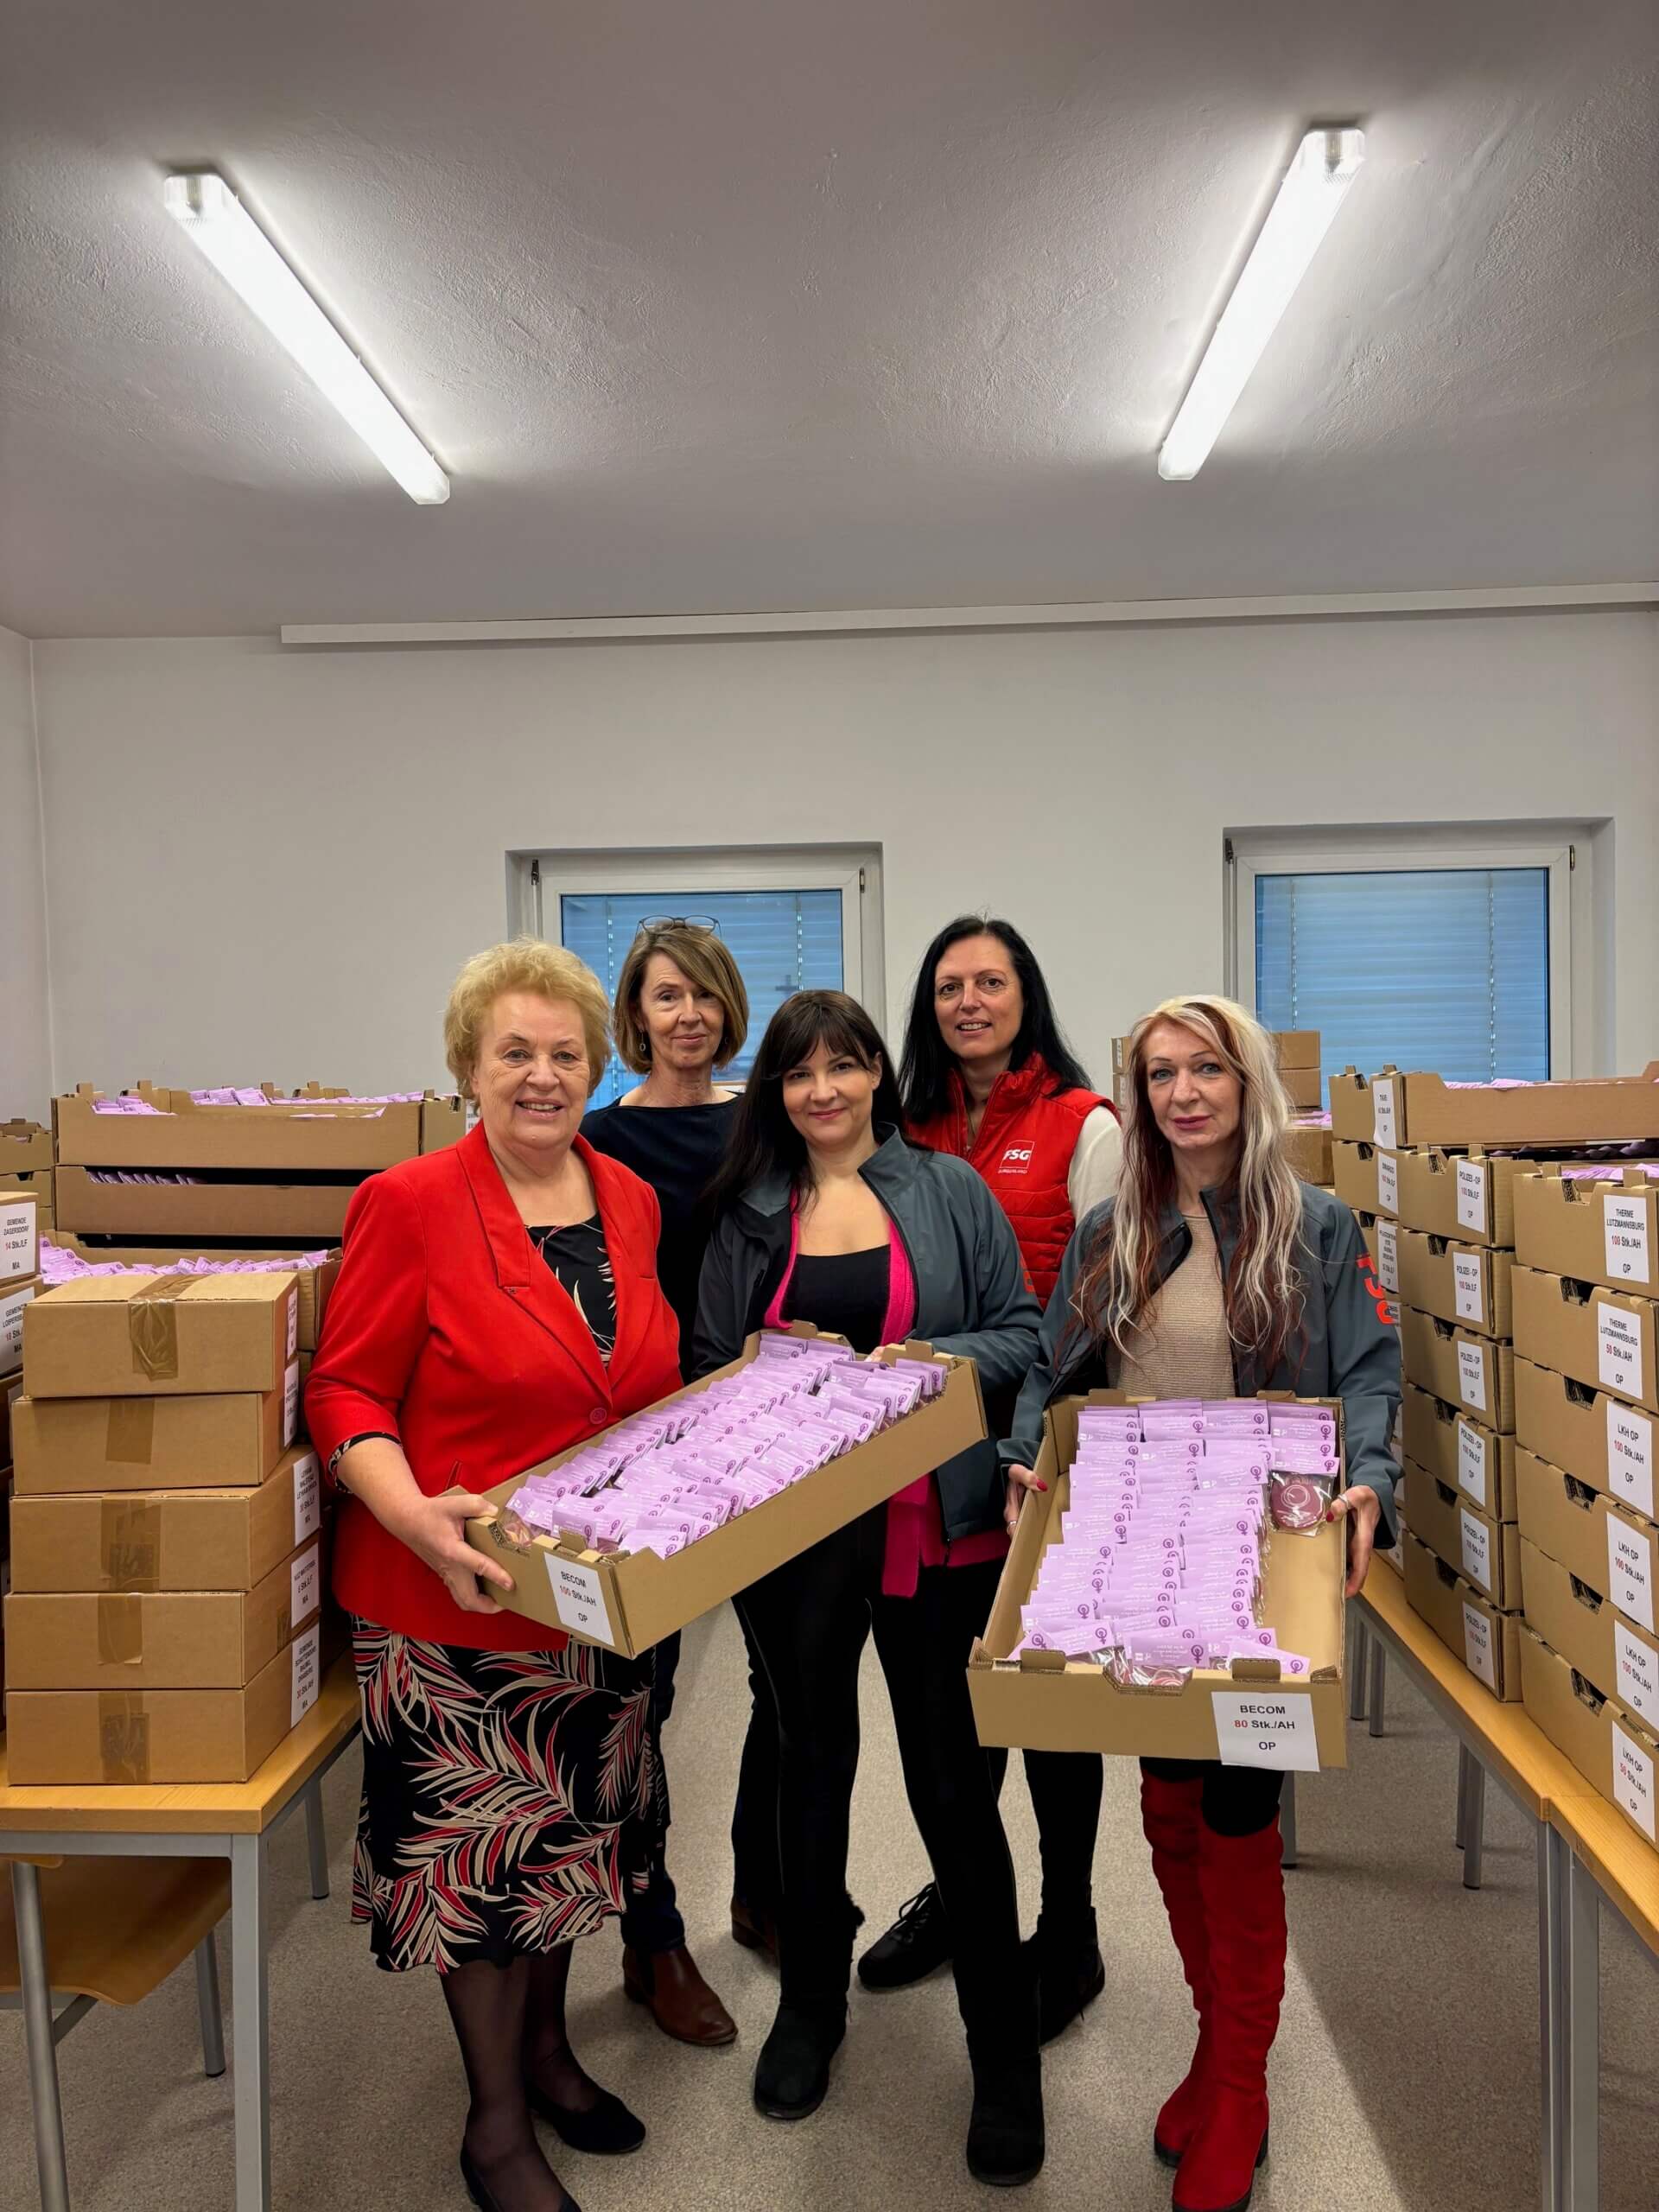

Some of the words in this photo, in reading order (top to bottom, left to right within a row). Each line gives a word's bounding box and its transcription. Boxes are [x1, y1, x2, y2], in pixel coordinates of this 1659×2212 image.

[1003, 1149, 1032, 1160] FSG
[1616, 1209, 1634, 1217] THERME
[1607, 1218, 1644, 1230] LUTZMANNSBURG
[1611, 1236, 1620, 1245] 100
[1621, 1236, 1641, 1249] Stk./AH
[1623, 1263, 1630, 1274] OP
[1466, 1303, 1471, 1312] OP
[1609, 1318, 1627, 1331] THERME
[1600, 1326, 1637, 1346] LUTZMANNSBURG
[14, 1344, 22, 1353] MA
[1606, 1344, 1612, 1355] 50
[1613, 1346, 1632, 1362] Stk./AH
[1616, 1374, 1624, 1384] OP
[1618, 1424, 1629, 1438] LKH
[1630, 1431, 1638, 1441] OP
[1614, 1440, 1623, 1452] 100
[1624, 1446, 1644, 1465] Stk./AH
[1625, 1472, 1633, 1484] OP
[1618, 1541, 1630, 1555] LKH
[1630, 1549, 1638, 1561] OP
[1615, 1557, 1624, 1570] 100
[1624, 1563, 1645, 1585] Stk./AH
[561, 1571, 586, 1587] BECOM
[572, 1590, 596, 1606] Stk./AH
[1626, 1591, 1635, 1603] OP
[578, 1612, 588, 1623] OP
[1626, 1645, 1637, 1662] LKH
[1638, 1656, 1646, 1668] OP
[1623, 1661, 1631, 1675] 100
[1632, 1669, 1652, 1693] Stk./AH
[1634, 1695, 1642, 1707] OP
[1240, 1705, 1286, 1714] BECOM
[1234, 1719, 1248, 1728] 80
[1251, 1719, 1295, 1729] Stk./AH
[1258, 1741, 1276, 1751] OP
[1623, 1747, 1633, 1765] LKH
[1635, 1761, 1643, 1773] OP
[1620, 1763, 1626, 1776] 50
[1627, 1770, 1647, 1797] Stk./AH
[1630, 1799, 1637, 1811] OP
